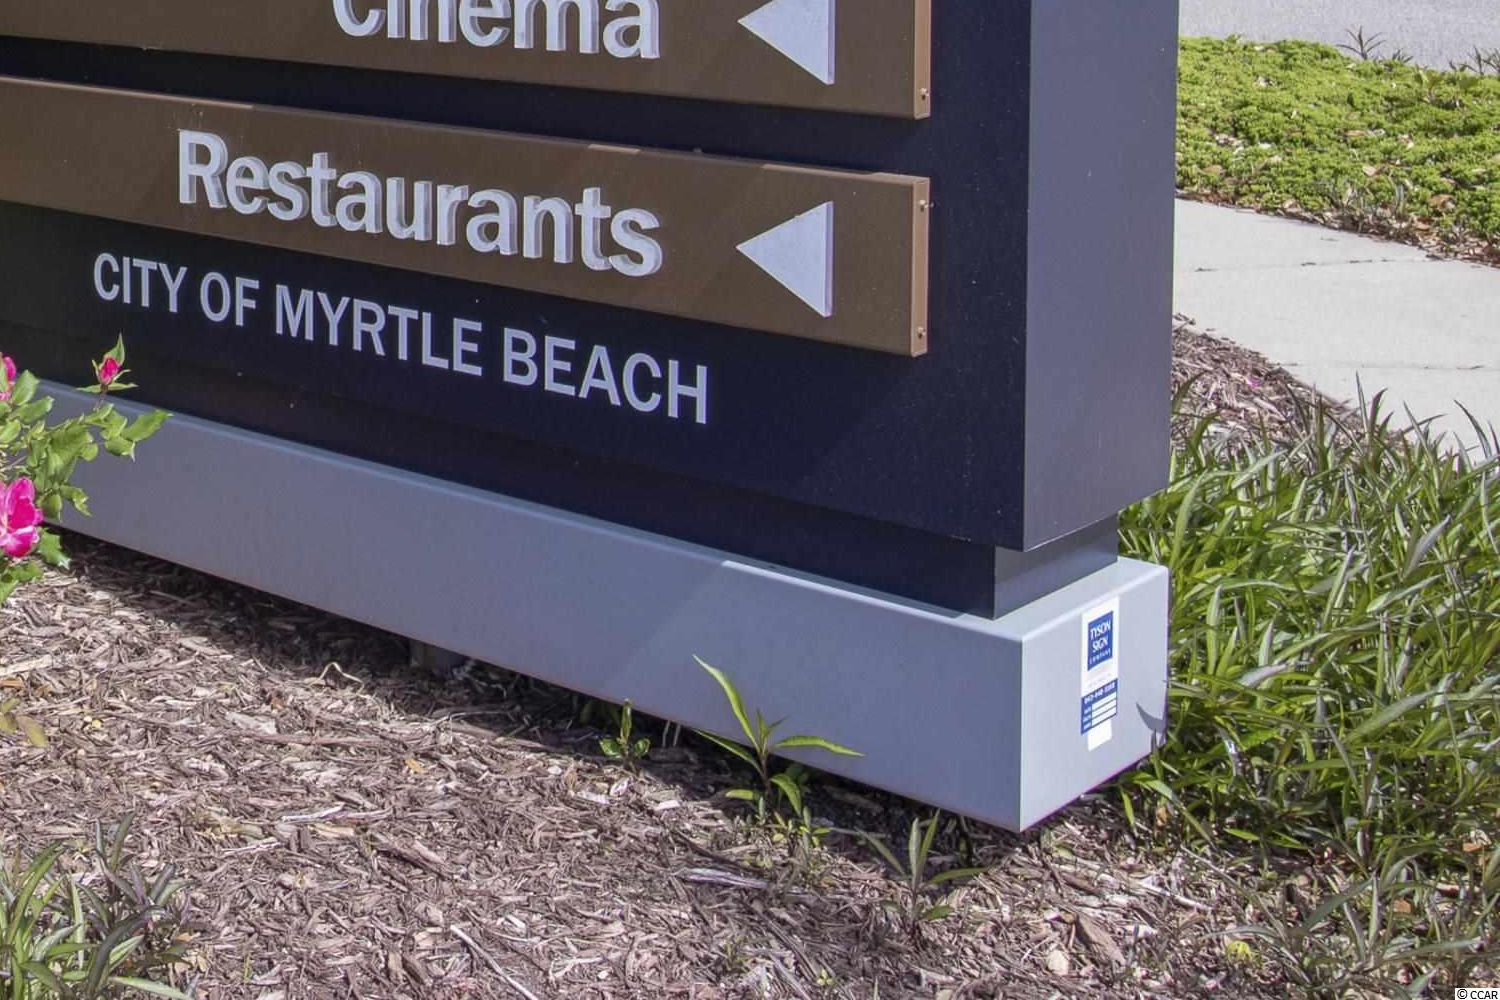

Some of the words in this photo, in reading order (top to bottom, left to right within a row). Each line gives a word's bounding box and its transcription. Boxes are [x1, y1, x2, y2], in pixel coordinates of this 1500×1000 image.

[178, 128, 663, 277] Restaurants
[94, 252, 188, 313] CITY
[200, 271, 260, 327] OF
[275, 284, 483, 377] MYRTLE
[503, 327, 708, 425] BEACH
[1090, 620, 1111, 640] TYSON
[1092, 635, 1108, 652] SIGN
